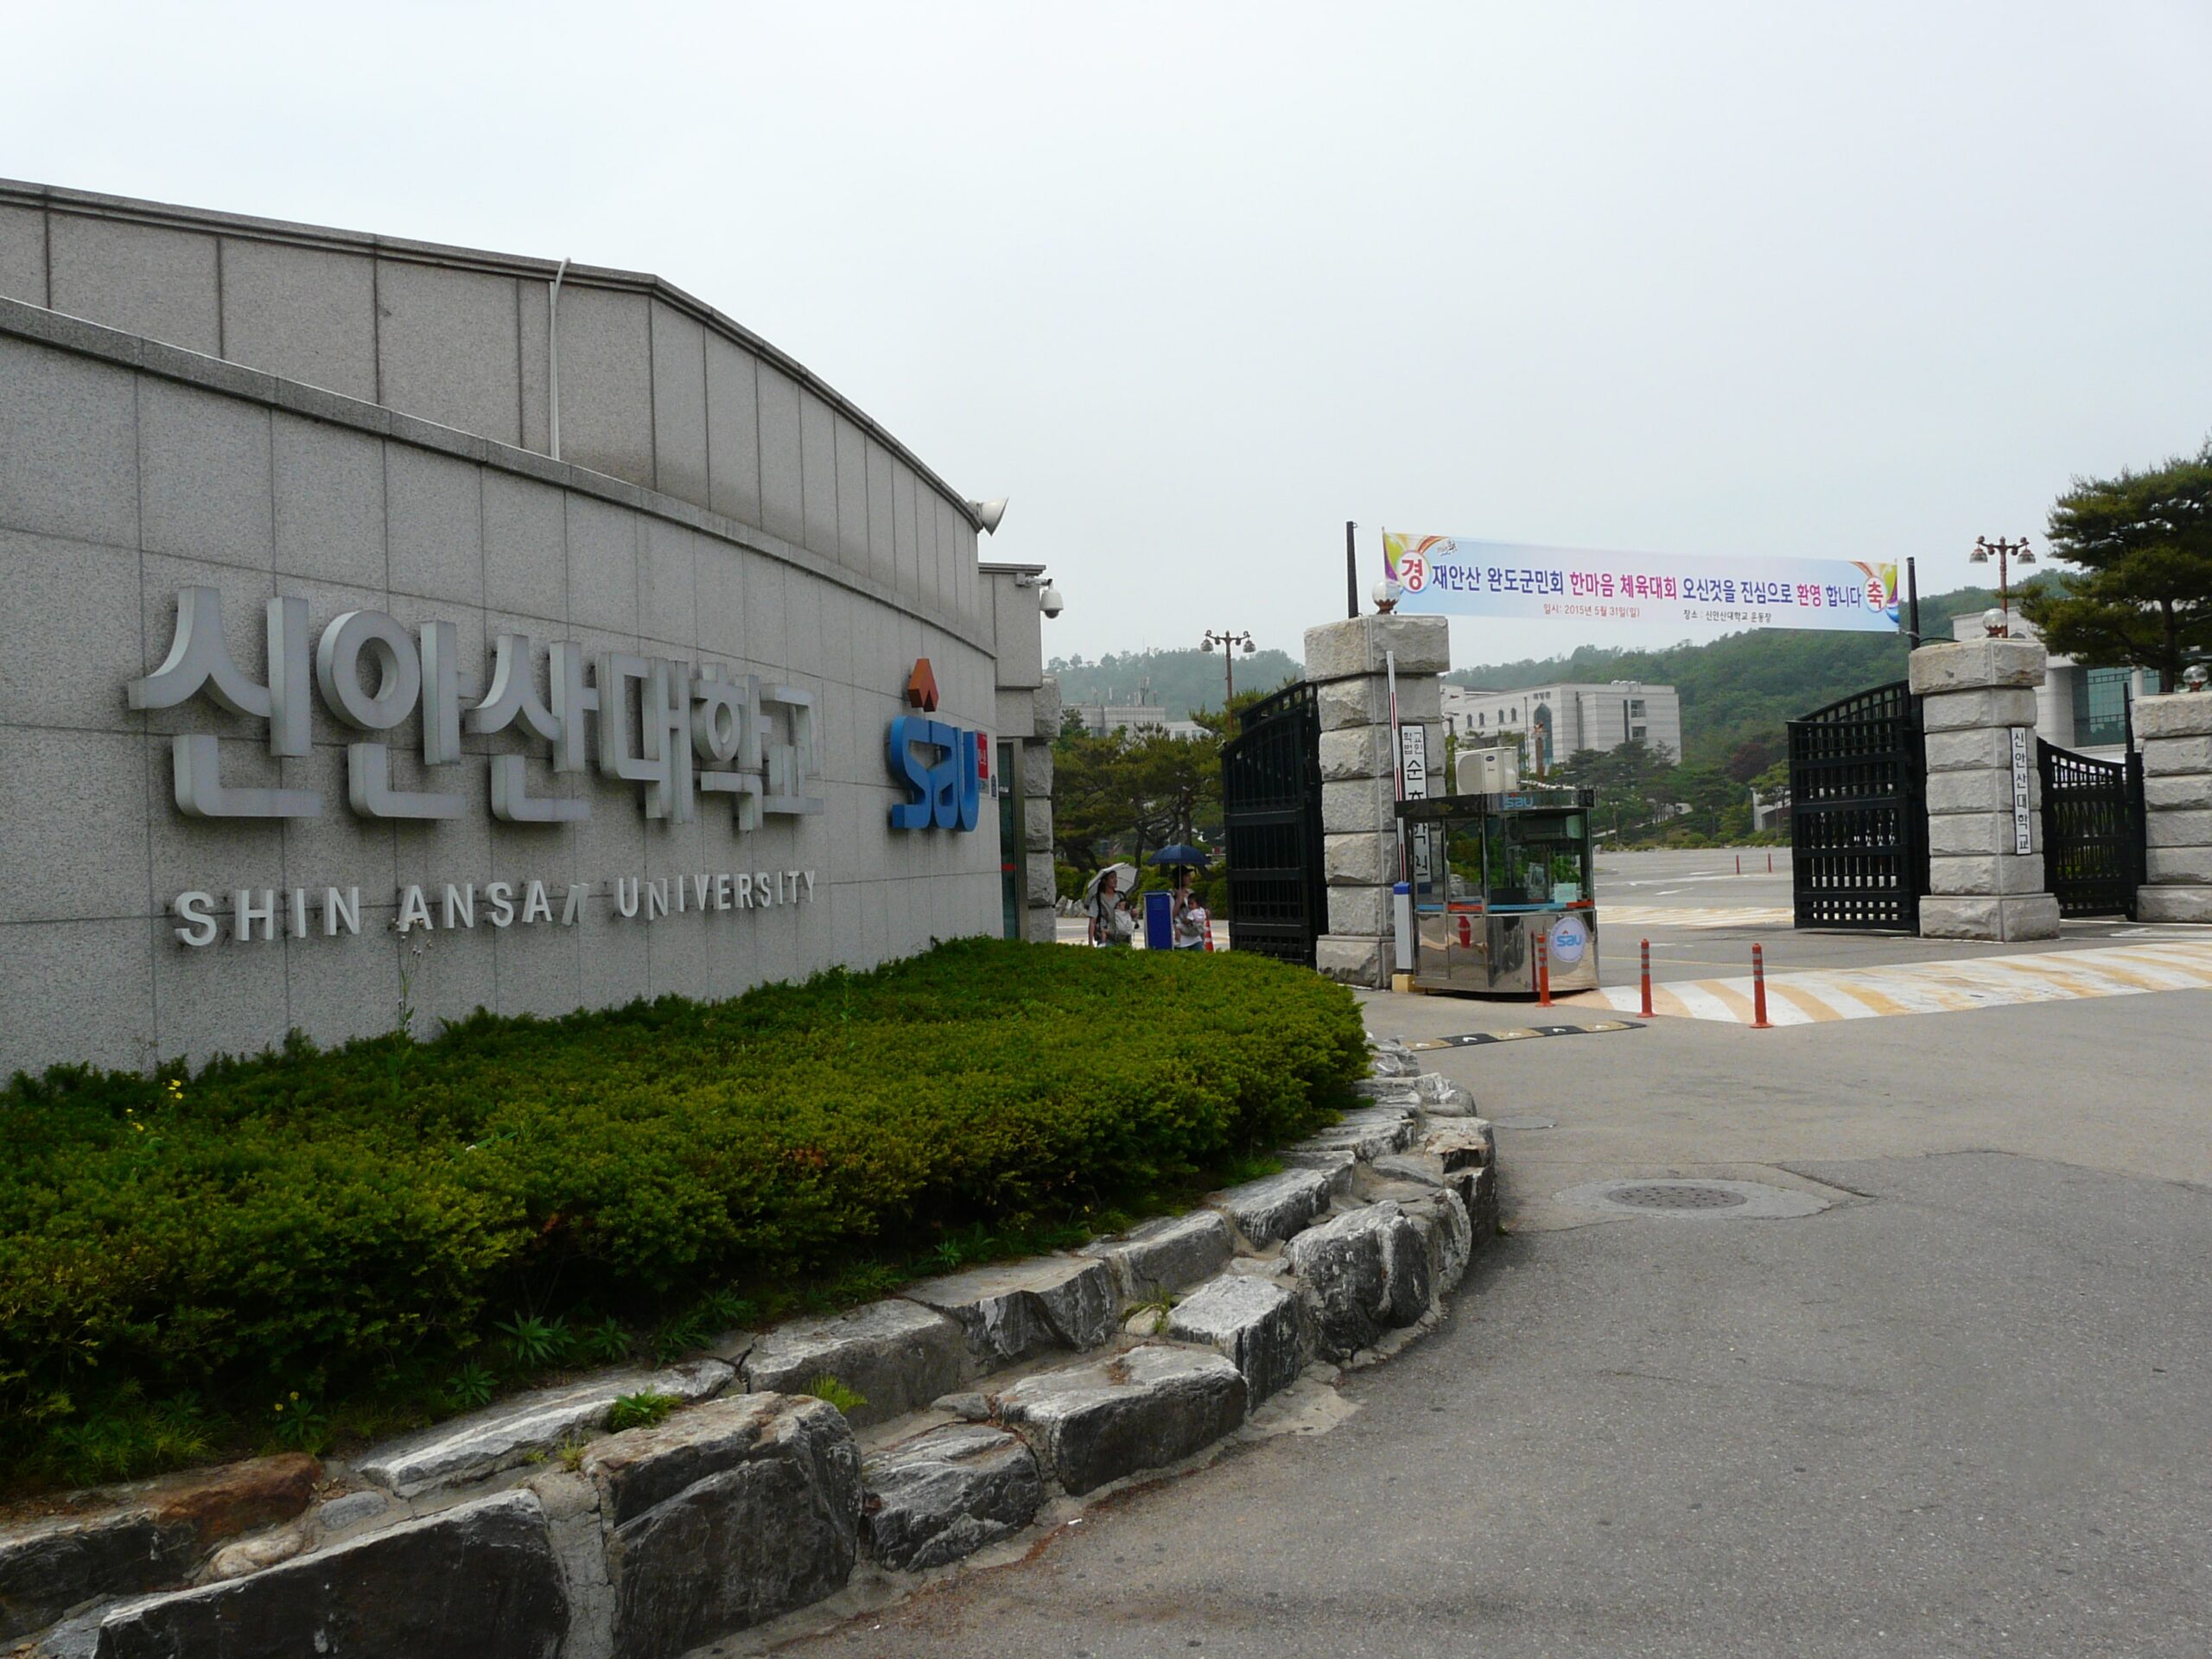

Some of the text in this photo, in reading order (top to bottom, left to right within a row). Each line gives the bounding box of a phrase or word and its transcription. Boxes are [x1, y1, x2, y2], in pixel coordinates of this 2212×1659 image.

[1402, 558, 1424, 592] 경
[1432, 565, 1861, 609] 재안산 완도군민회 한마음 체육대회 오신것을 진심으로 환영 합니다
[1866, 581, 1885, 608] 축
[1542, 603, 1640, 620] 일시: 2015년 5월 31일(일)
[1683, 608, 1698, 620] 장소
[129, 585, 824, 832] 신안산대학교
[2014, 732, 2029, 849] 신안산대학교
[175, 886, 362, 948] SHIN
[617, 868, 818, 921] UNIVERSITY
